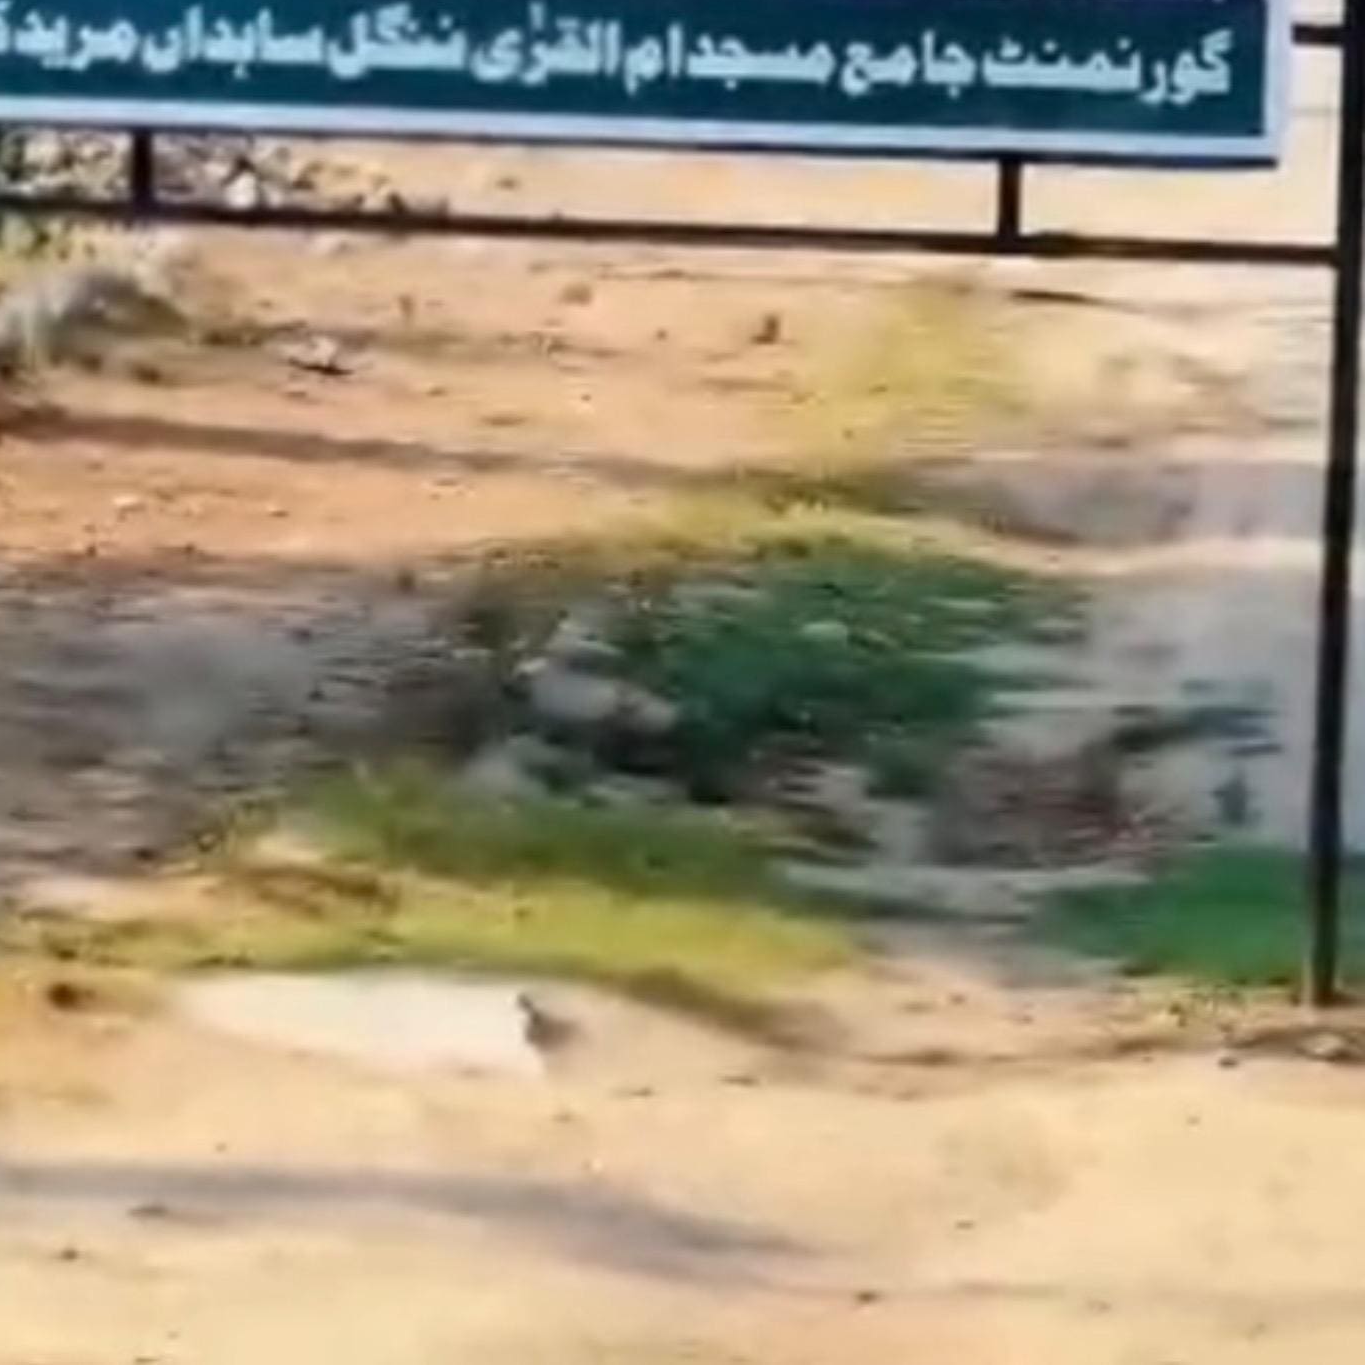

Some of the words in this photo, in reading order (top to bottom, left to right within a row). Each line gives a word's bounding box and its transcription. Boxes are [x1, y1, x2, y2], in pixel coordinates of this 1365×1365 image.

[687, 34, 836, 90] مسجد
[842, 30, 976, 98] جامع
[982, 29, 1231, 103] گورنمنٹ
